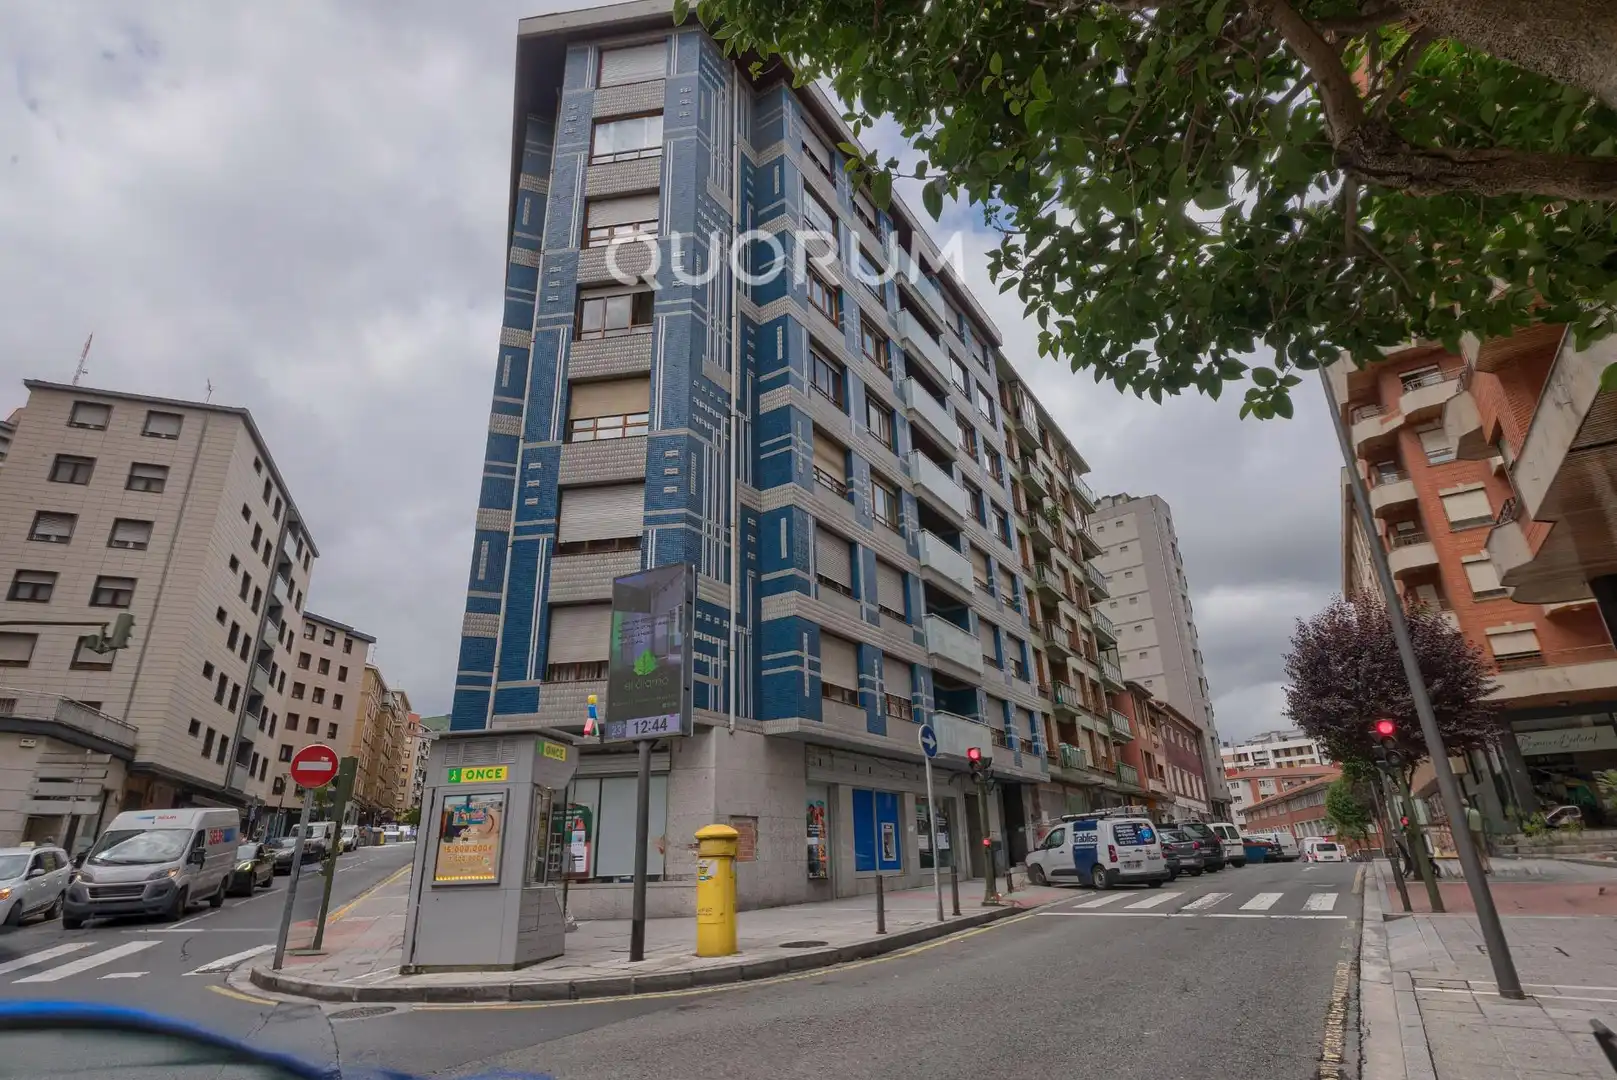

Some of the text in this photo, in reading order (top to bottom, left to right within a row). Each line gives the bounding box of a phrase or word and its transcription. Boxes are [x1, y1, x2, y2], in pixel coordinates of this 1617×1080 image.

[633, 717, 668, 735] 12:44
[545, 745, 564, 759] ONCE
[465, 768, 503, 780] ONCE
[1072, 832, 1098, 843] Trablisa
